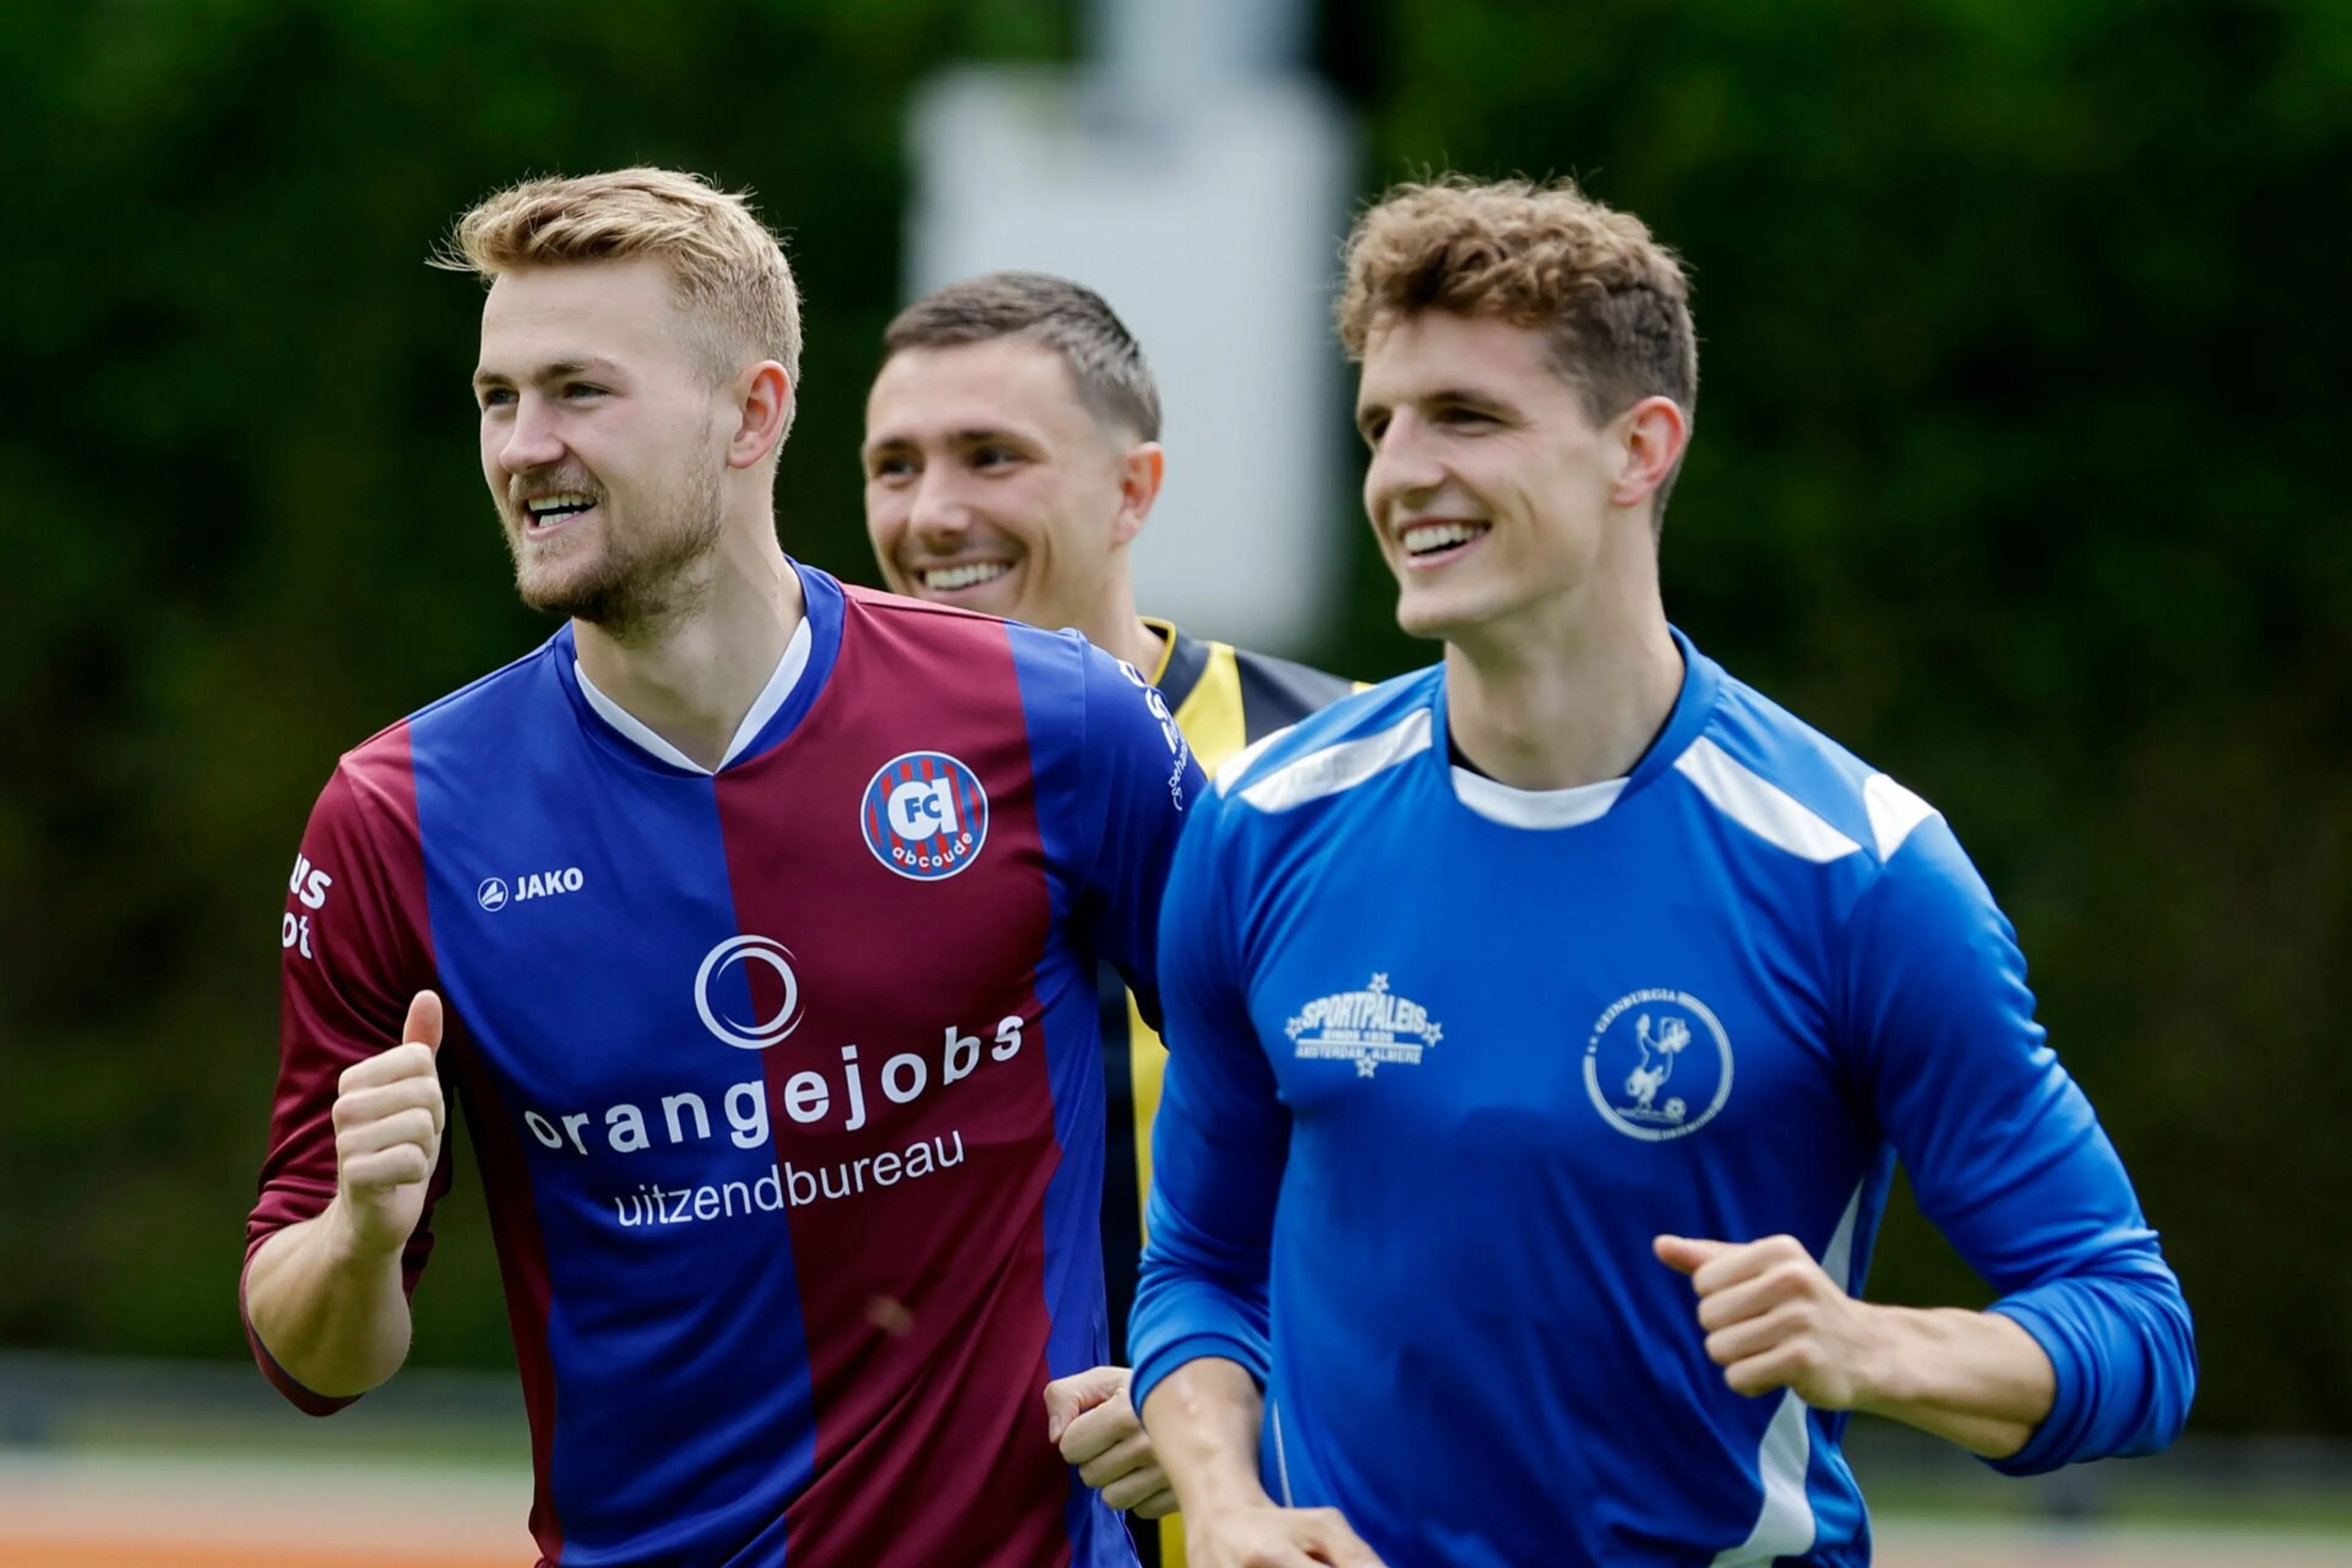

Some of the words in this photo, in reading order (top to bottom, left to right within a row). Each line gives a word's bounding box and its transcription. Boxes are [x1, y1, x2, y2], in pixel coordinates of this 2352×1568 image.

[904, 793, 943, 824] FC
[892, 832, 973, 867] abcoude
[514, 867, 584, 902] JAKO
[1301, 990, 1428, 1035] SPORTPALEIS
[524, 1014, 1025, 1156] orangejobs
[614, 1129, 965, 1227] uitzendbureau
